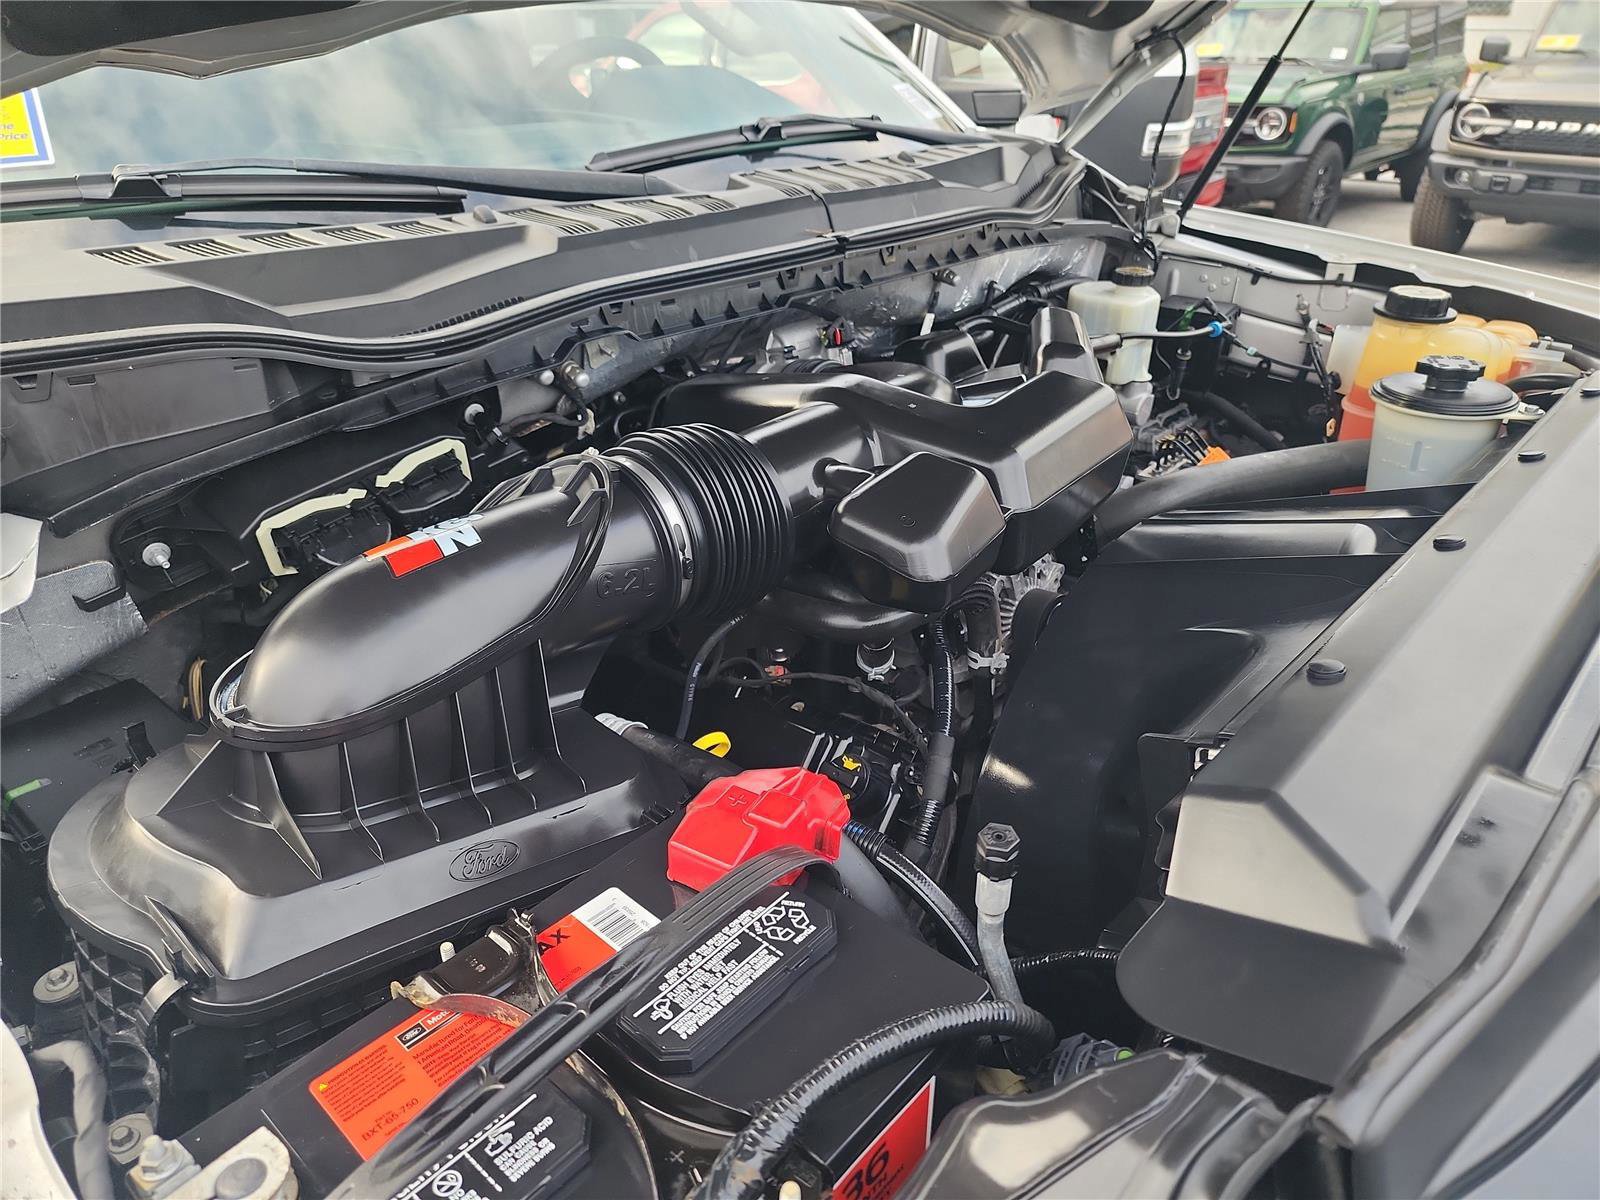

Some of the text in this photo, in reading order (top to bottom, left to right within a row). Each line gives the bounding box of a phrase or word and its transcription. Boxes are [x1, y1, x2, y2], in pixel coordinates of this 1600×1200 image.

[597, 567, 656, 600] 6.2L
[462, 843, 509, 880] Ford
[667, 939, 741, 999] FLUSH EYES IMMEDIATELY
[673, 989, 692, 1004] WITH
[712, 961, 726, 972] GET
[679, 960, 738, 1009] MEDICAL HELP FAST
[493, 1116, 554, 1166] SULFURIC ACID
